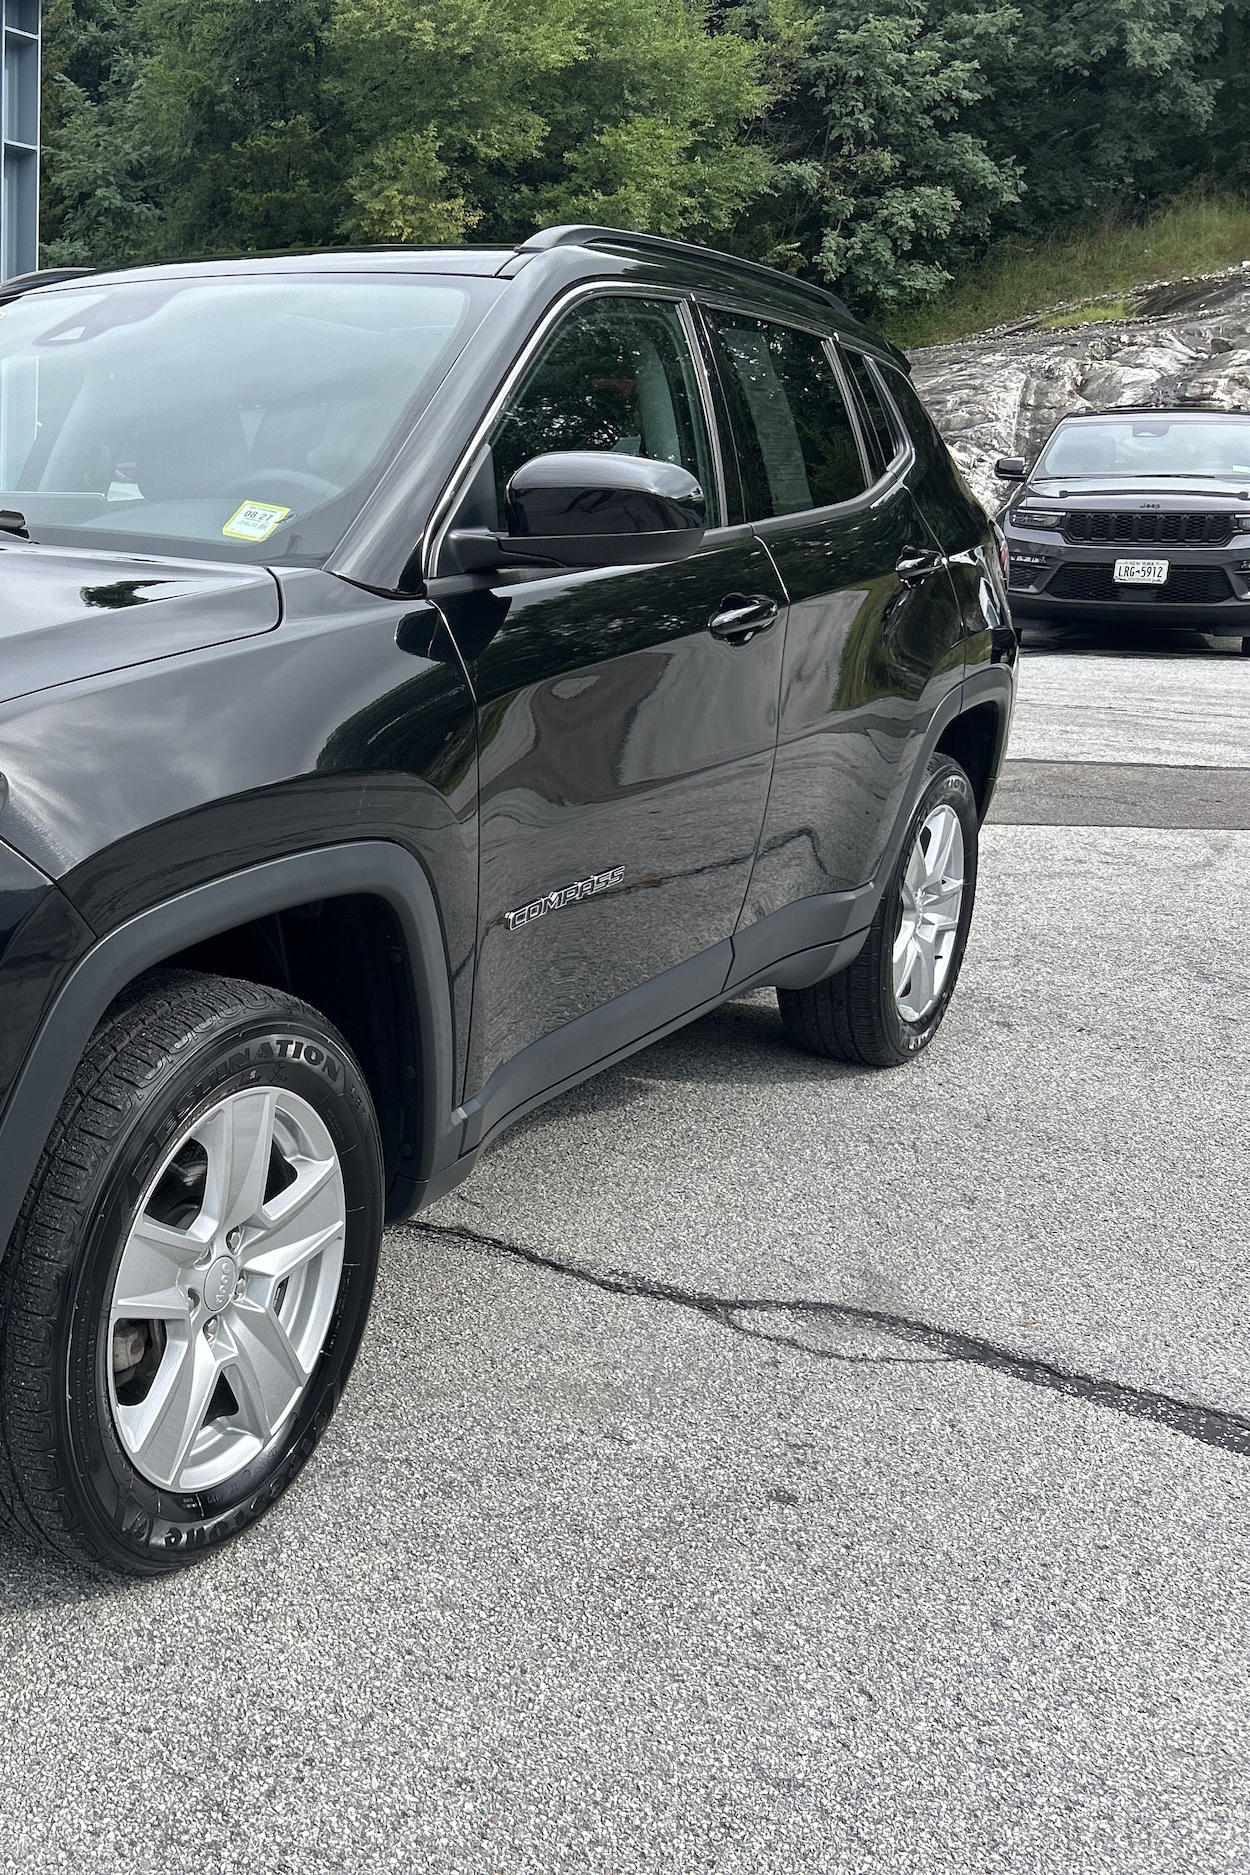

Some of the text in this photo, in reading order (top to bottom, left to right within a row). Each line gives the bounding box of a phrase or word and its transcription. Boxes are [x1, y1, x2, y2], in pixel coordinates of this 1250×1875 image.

[244, 510, 258, 519] 08
[258, 513, 274, 521] 27
[504, 865, 626, 931] COMPASS
[132, 1039, 342, 1181] DESTINATION
